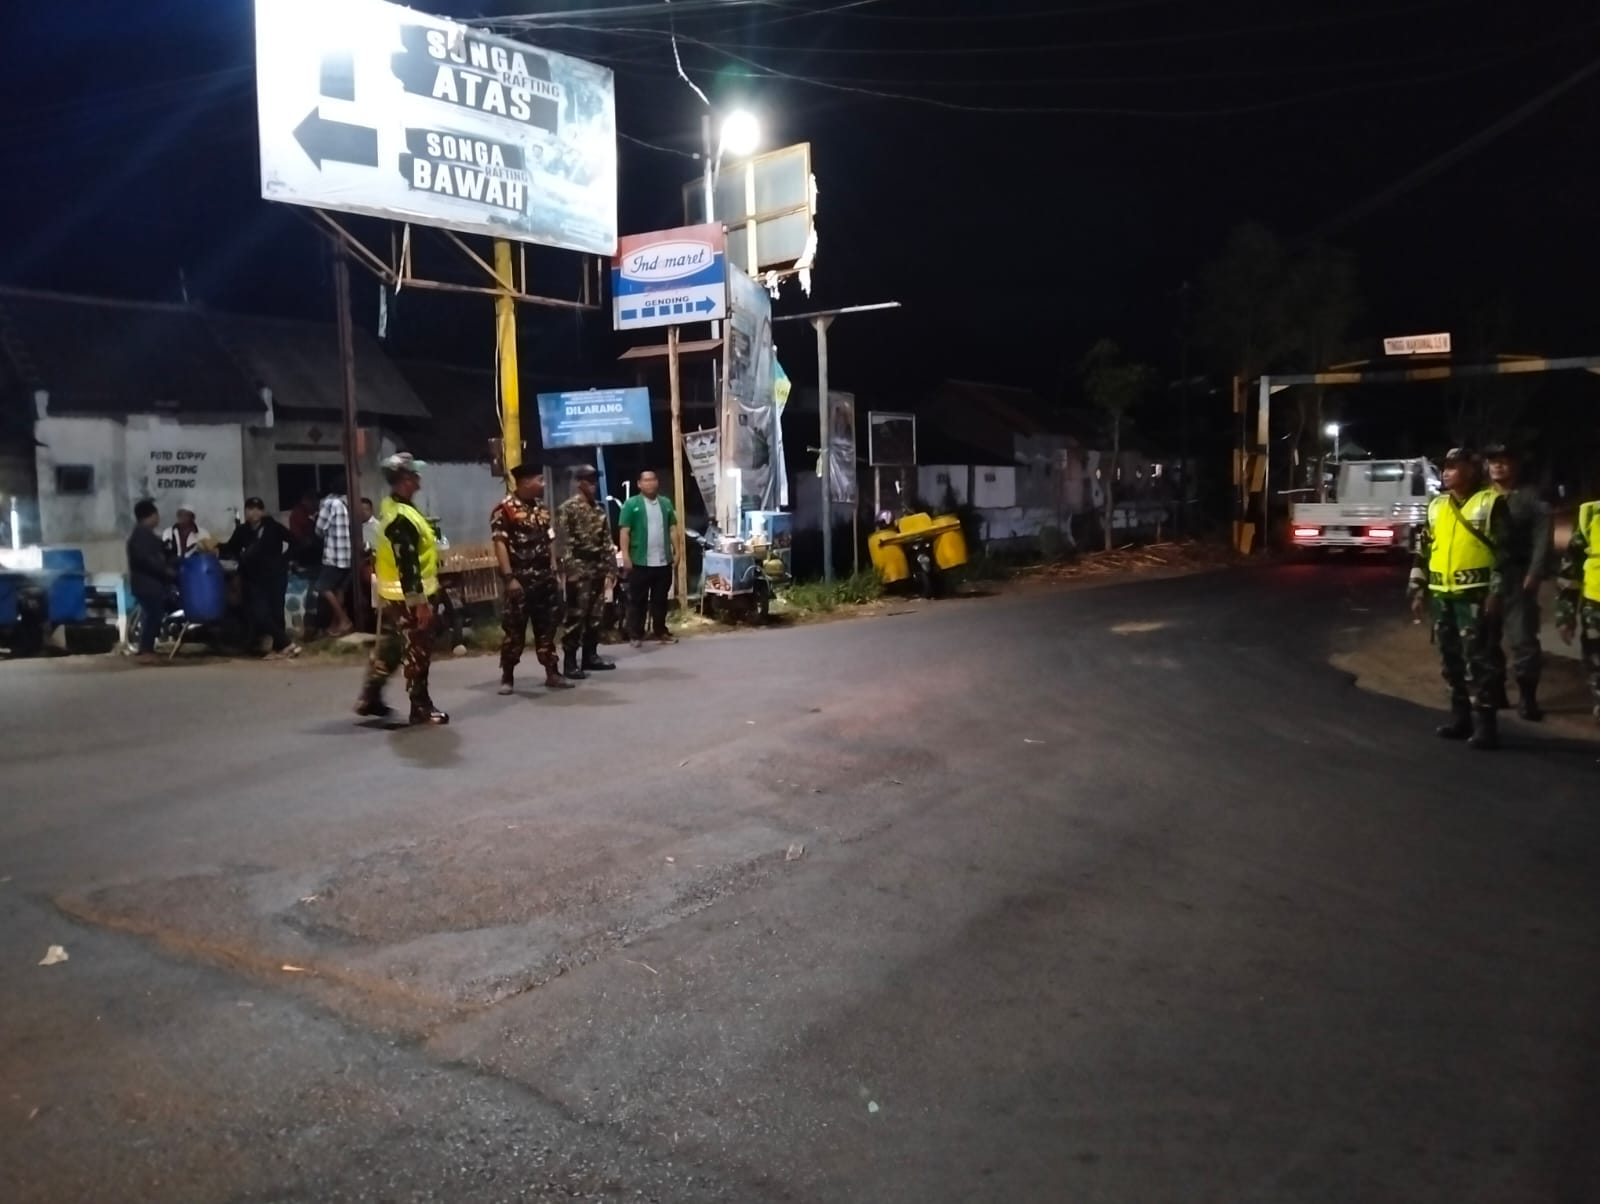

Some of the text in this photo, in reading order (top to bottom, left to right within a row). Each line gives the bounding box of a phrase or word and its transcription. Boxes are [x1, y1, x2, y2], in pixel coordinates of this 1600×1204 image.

[432, 65, 531, 121] ATAS
[502, 71, 561, 98] RAFTING
[426, 132, 504, 167] SONGA
[413, 157, 523, 210] BAWAH
[631, 249, 704, 273] Indmaret
[645, 296, 690, 306] GENDING
[565, 403, 624, 416] DILARANG
[150, 451, 173, 461] FOTO
[155, 464, 198, 475] SHOTING
[157, 478, 196, 489] EDITING
